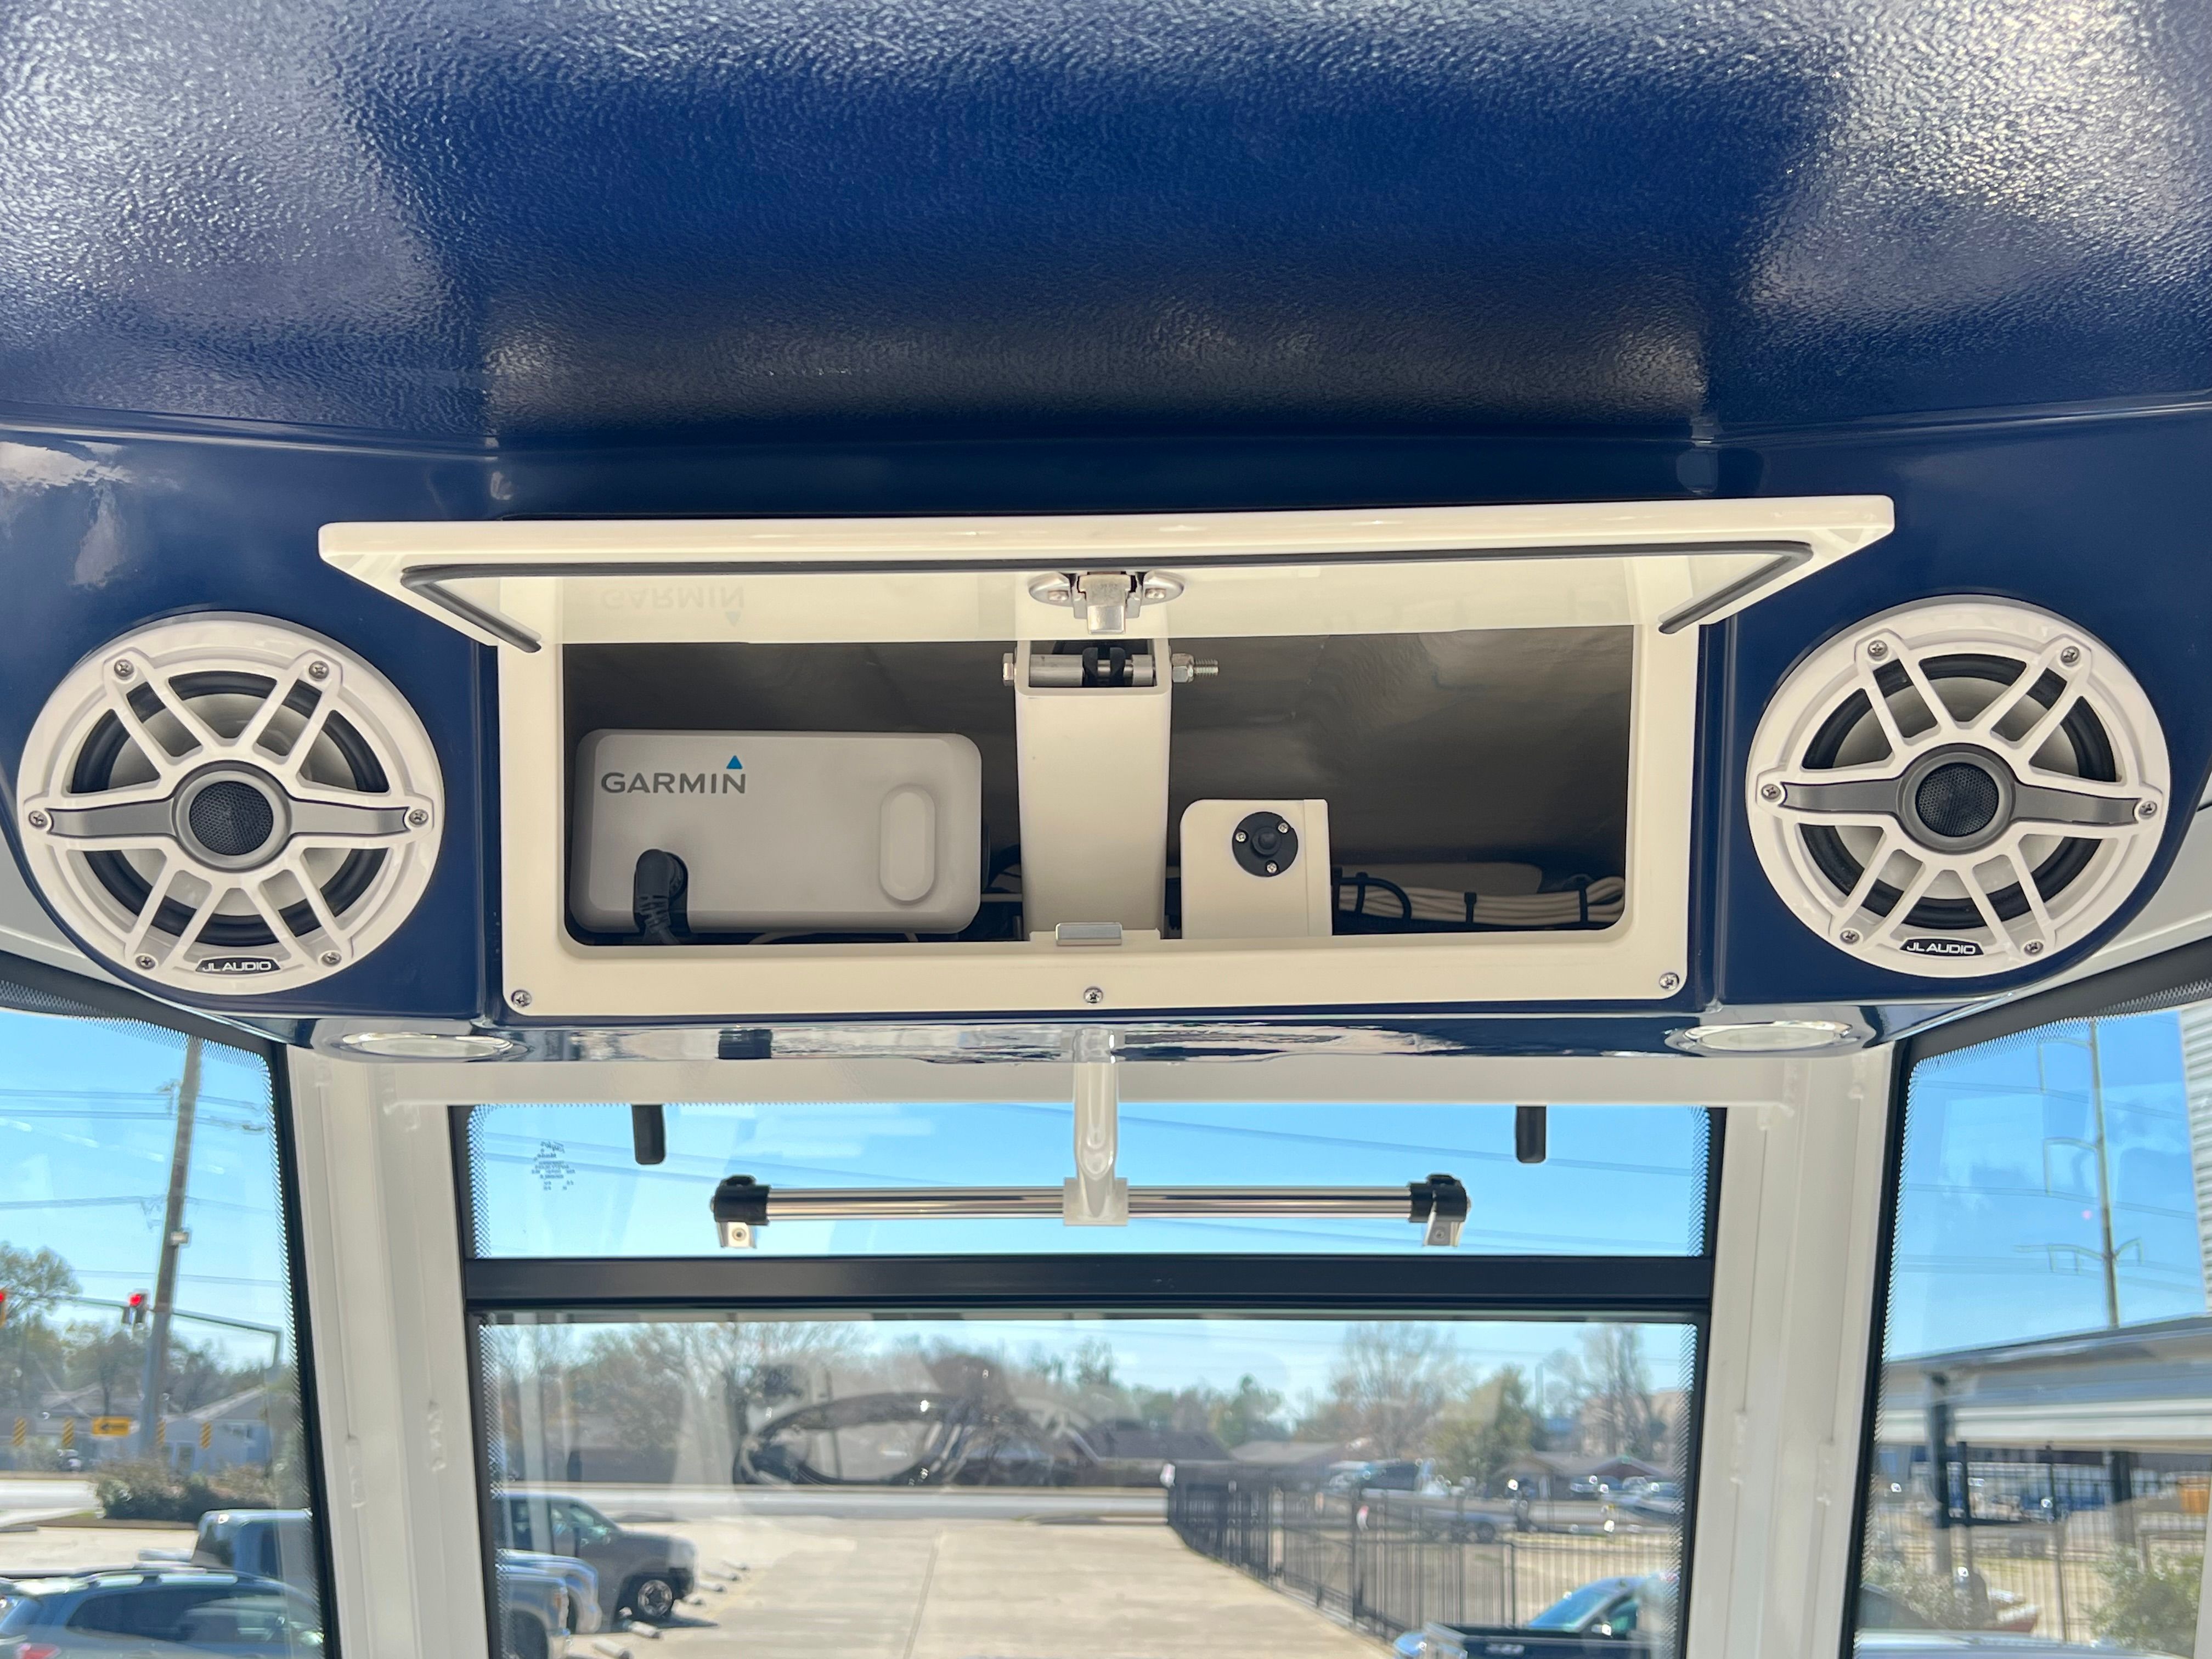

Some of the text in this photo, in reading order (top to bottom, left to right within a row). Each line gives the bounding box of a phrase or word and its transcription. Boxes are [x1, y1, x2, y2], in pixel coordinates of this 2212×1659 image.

[601, 772, 746, 794] GARMIN
[1906, 942, 1976, 955] JL AUDIO
[202, 961, 272, 972] JL AUDIO
